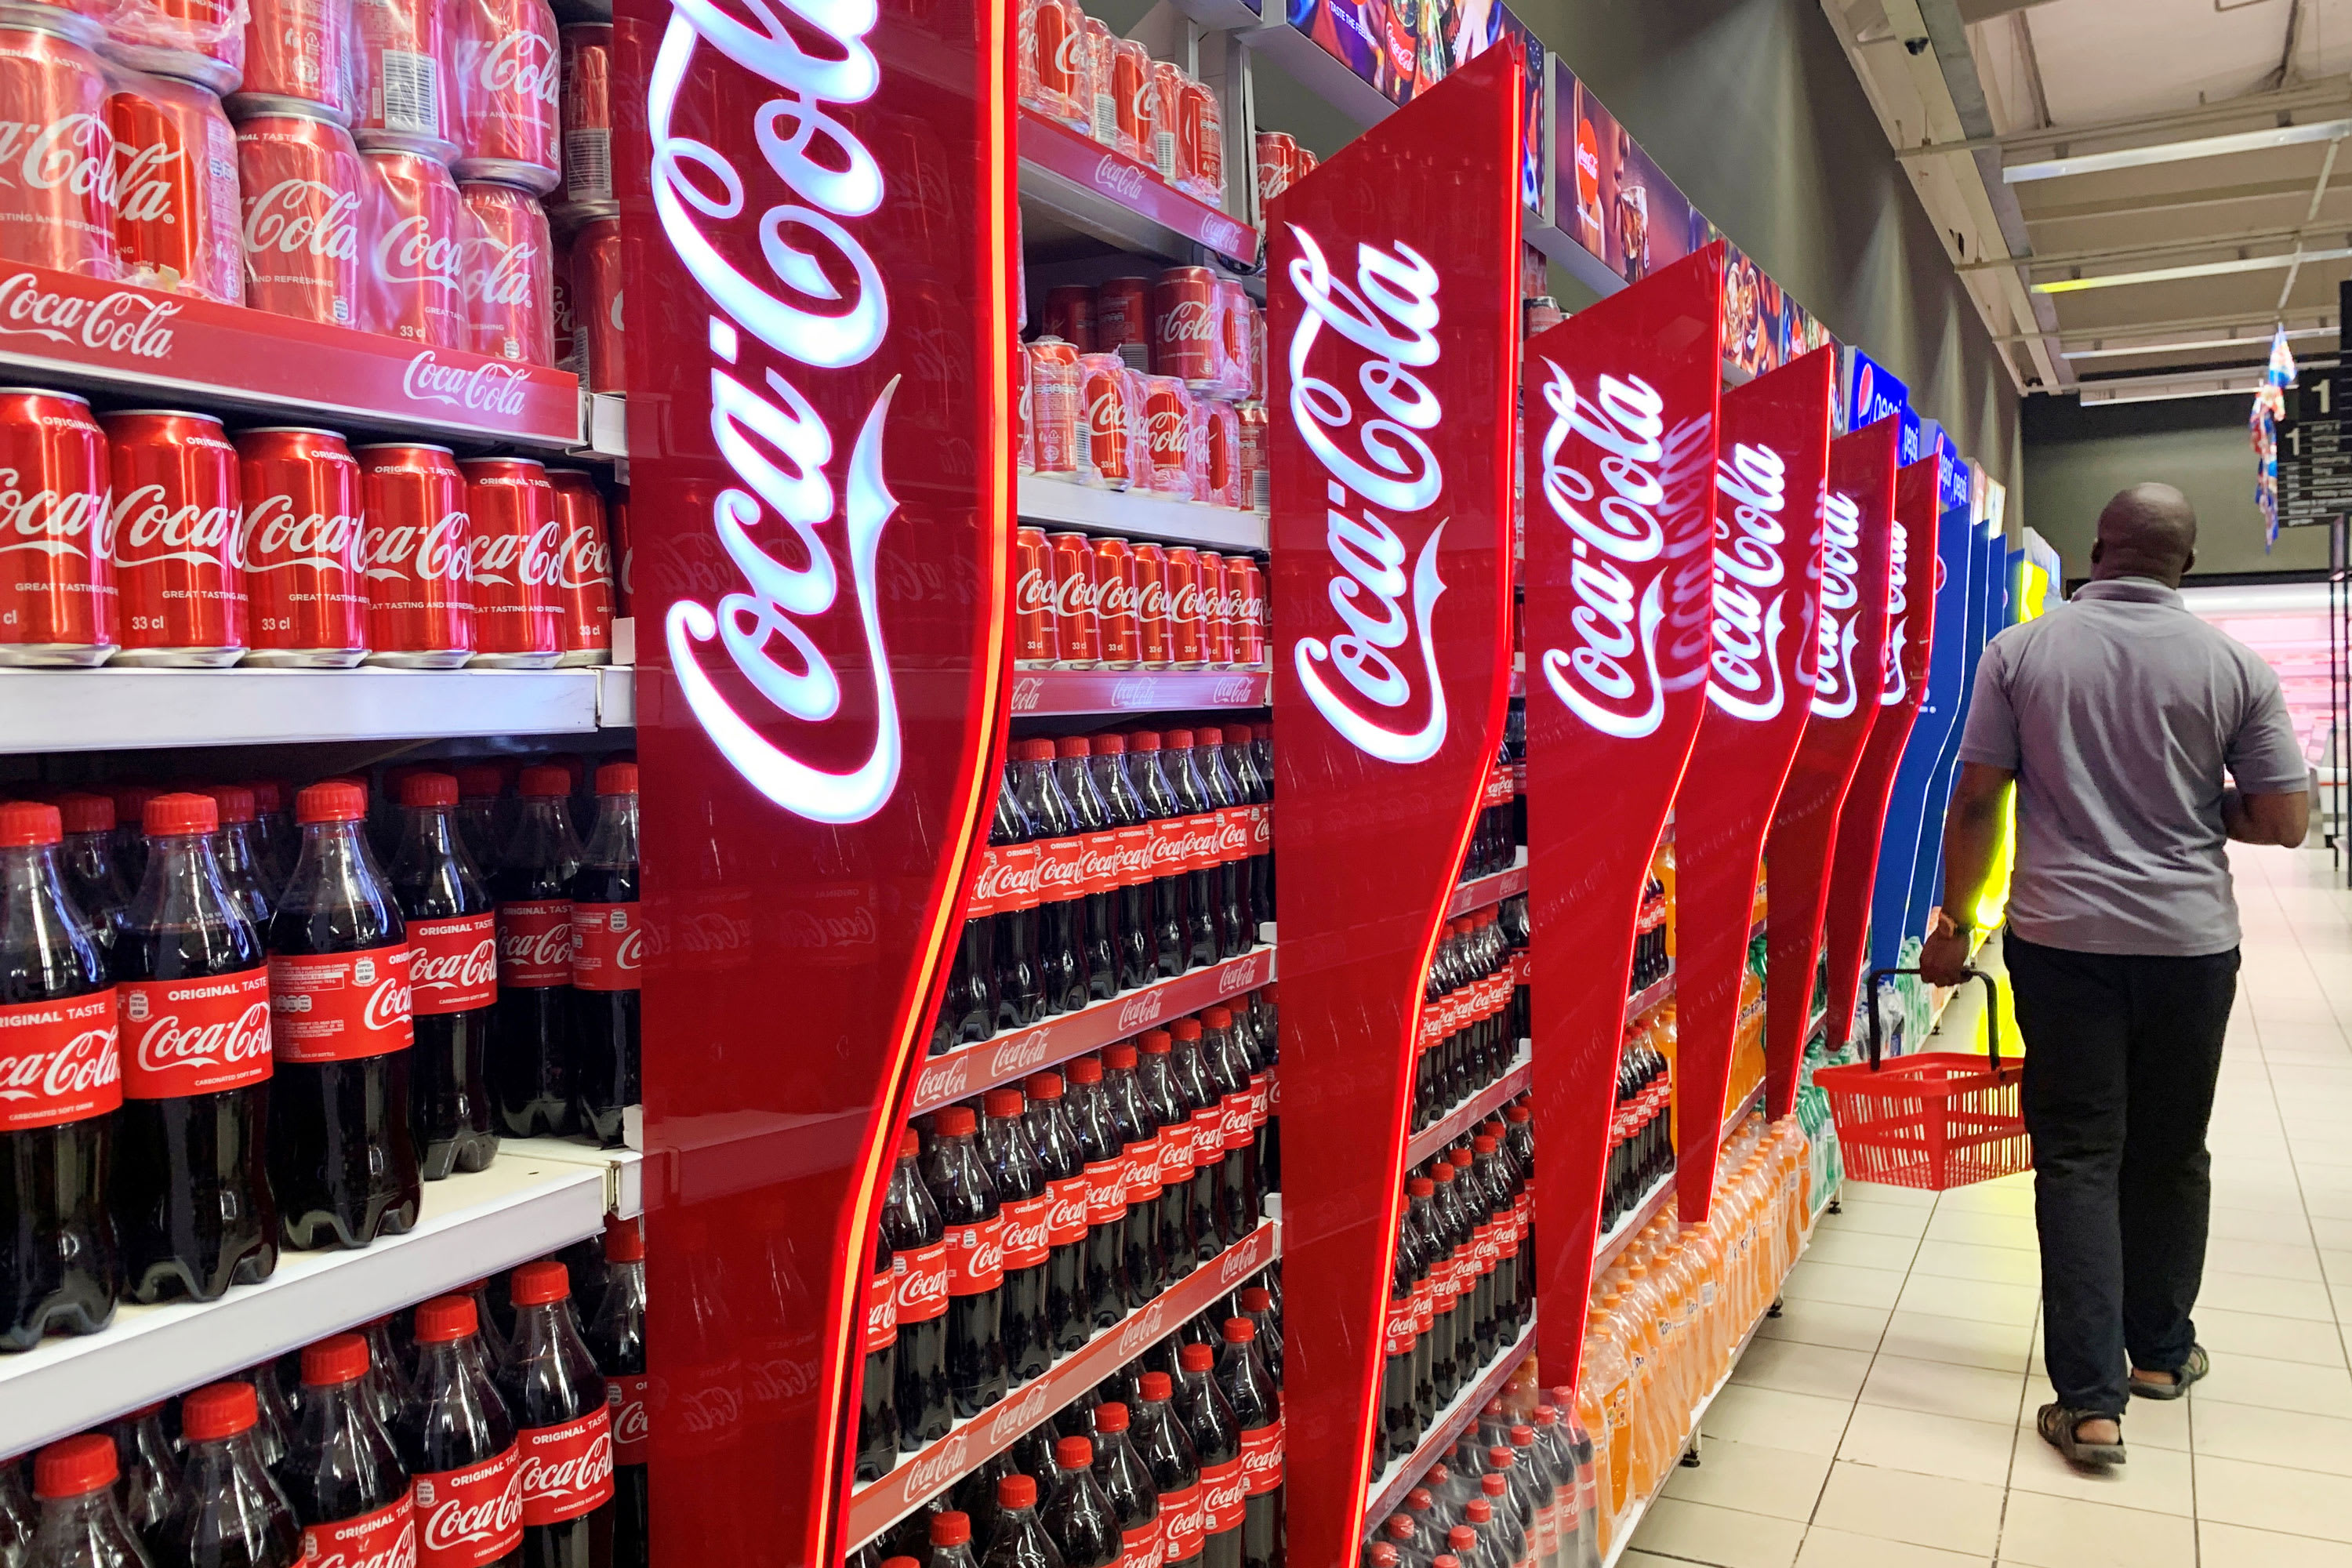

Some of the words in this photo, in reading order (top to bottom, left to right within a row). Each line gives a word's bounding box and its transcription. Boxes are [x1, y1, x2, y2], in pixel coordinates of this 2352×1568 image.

[1345, 14, 1356, 29] THE
[470, 29, 560, 108] -Cola
[1094, 154, 1147, 200] Coca-Cola
[0, 212, 33, 223] STING
[245, 179, 362, 265] -Cola
[274, 275, 333, 288] REFRESHING
[0, 274, 184, 358] Coca-Cola
[400, 325, 415, 337] 33
[403, 350, 532, 416] Coca-Cola
[2311, 379, 2330, 413] 1
[42, 416, 98, 431] ORIGINAL
[186, 436, 232, 451] ORIGINAL
[2285, 427, 2299, 456] 1
[311, 450, 353, 463] ORIGINAL
[430, 466, 456, 477] TASTE
[1284, 220, 1449, 764] Coca-Cola
[1954, 473, 1967, 506] pepsi
[1539, 355, 1668, 739] Coca-Cola
[59, 583, 100, 593] TASTING
[162, 590, 198, 599] GREAT
[201, 590, 236, 600] TASTING
[289, 593, 322, 602] GREAT
[325, 593, 358, 603] TASTING
[385, 602, 424, 611] TASTING
[132, 617, 147, 630] 33
[151, 615, 164, 629] cl
[261, 617, 276, 630] 33
[279, 617, 290, 630] cl
[579, 626, 591, 636] 33
[593, 625, 600, 635] cl
[1027, 641, 1036, 650] 33
[1072, 641, 1080, 650] 33
[1011, 677, 1044, 710] -Cola
[1051, 841, 1077, 850] ORIGINAL
[550, 904, 572, 914] TAST
[419, 924, 472, 935] ORIGINAL
[474, 918, 494, 931] TASTE
[1219, 956, 1258, 994] Coca-Cola
[168, 984, 239, 1002] ORIGINAL
[241, 976, 267, 992] TASTE
[0, 1011, 63, 1027] RIGINAL
[67, 1002, 106, 1019] TASTE
[1118, 988, 1163, 1032] Coca-Cola
[137, 1001, 273, 1072] Coca-Col
[992, 1027, 1051, 1077] Coca-Cola
[194, 1074, 236, 1087] CARBONATED
[9, 1109, 56, 1121] CARBONATED
[1221, 1235, 1259, 1284] Coca-Cola
[1119, 1298, 1165, 1356] Coca-Cola
[990, 1379, 1051, 1445] Coca-Cola
[532, 1425, 586, 1445] ORIGINAL
[588, 1410, 608, 1430] TASTE
[451, 1461, 504, 1487] ORIGINAL
[903, 1430, 967, 1504] Coca-Cola
[336, 1513, 394, 1541] ORIGINAL
